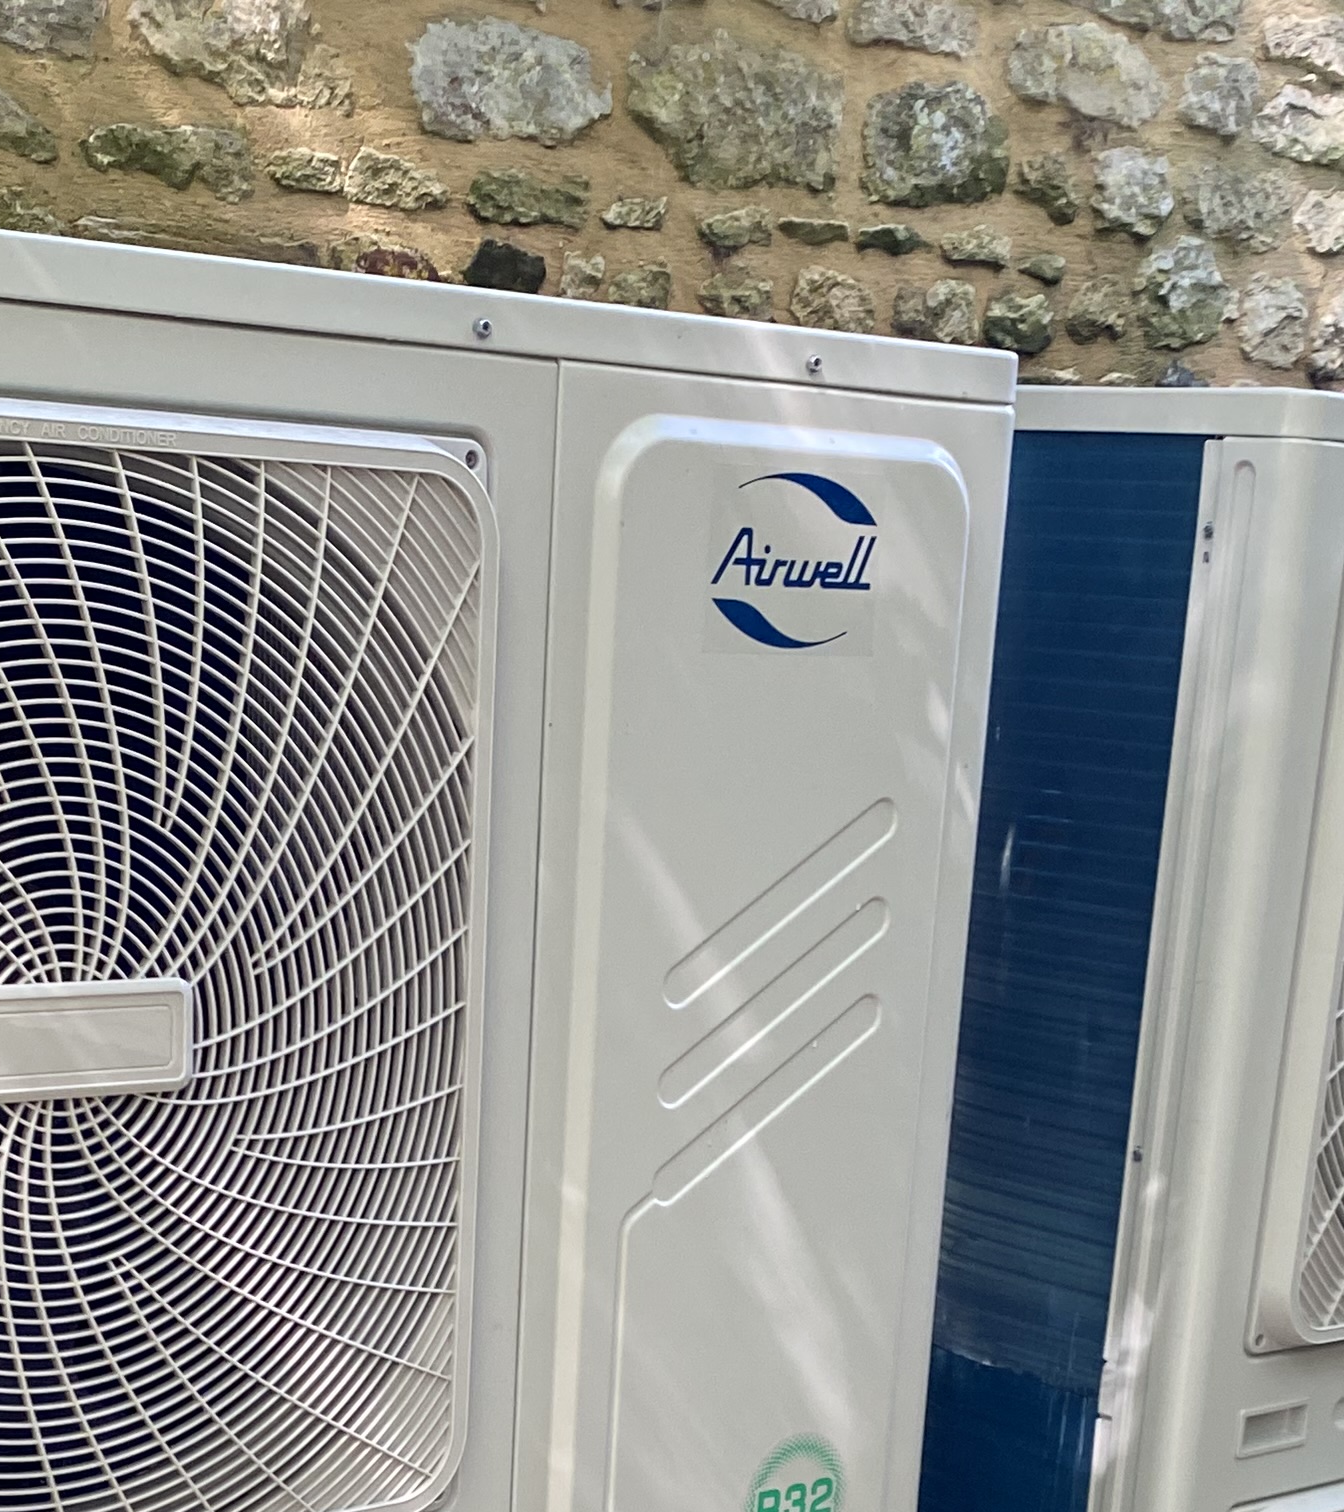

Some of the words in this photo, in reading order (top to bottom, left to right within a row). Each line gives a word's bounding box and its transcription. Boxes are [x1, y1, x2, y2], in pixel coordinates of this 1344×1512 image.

[41, 422, 66, 438] AIR
[78, 425, 177, 446] CONDITIONER
[711, 527, 877, 590] Airwell
